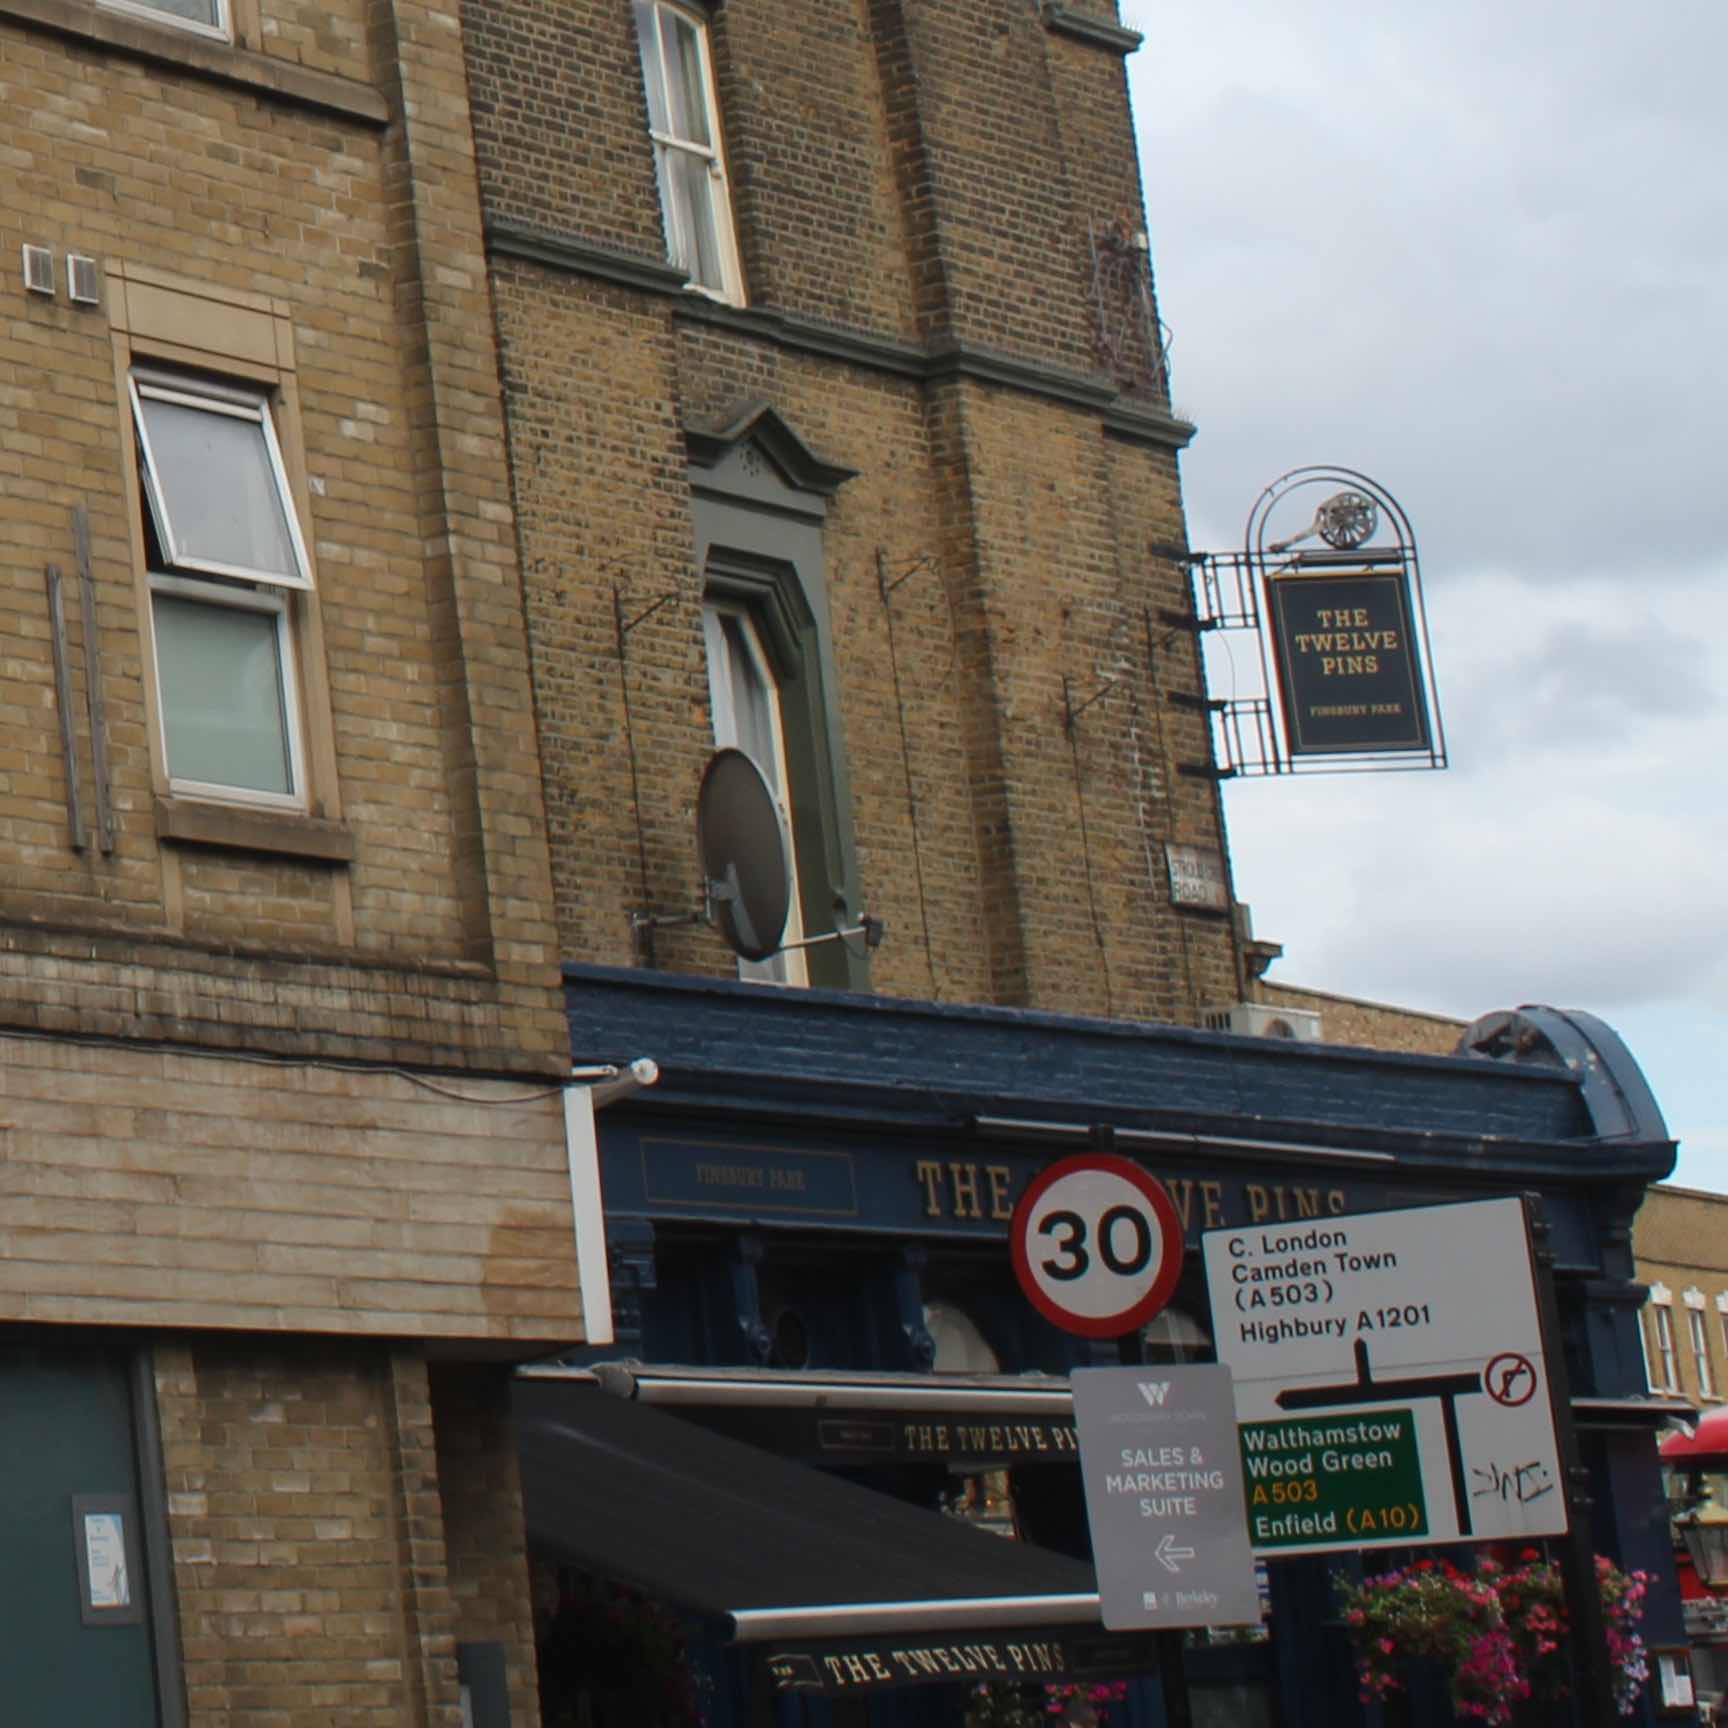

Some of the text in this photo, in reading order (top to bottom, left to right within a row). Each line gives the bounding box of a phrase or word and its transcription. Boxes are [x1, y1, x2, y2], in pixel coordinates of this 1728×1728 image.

[1317, 608, 1368, 628] THE
[1295, 630, 1398, 652] TWELVE
[1321, 656, 1379, 675] PINS
[917, 1160, 1015, 1220] THE
[1037, 1204, 1153, 1282] 30
[1228, 1228, 1347, 1259] C. London
[1231, 1252, 1398, 1284] Camden Town
[1240, 1304, 1431, 1344] Highbury A1201
[904, 1424, 951, 1451] THE
[956, 1424, 1048, 1451] TWELVE
[1244, 1421, 1403, 1452] Walthamstow
[1120, 1446, 1204, 1468] SALES &
[1246, 1449, 1394, 1479] Wood Green
[1105, 1471, 1225, 1494] MARKETING
[1252, 1479, 1318, 1506] A503
[1138, 1497, 1197, 1518] SUITE
[1255, 1503, 1421, 1539] Enfield (A10)
[824, 1641, 1066, 1686] THE TWELVE PINS
